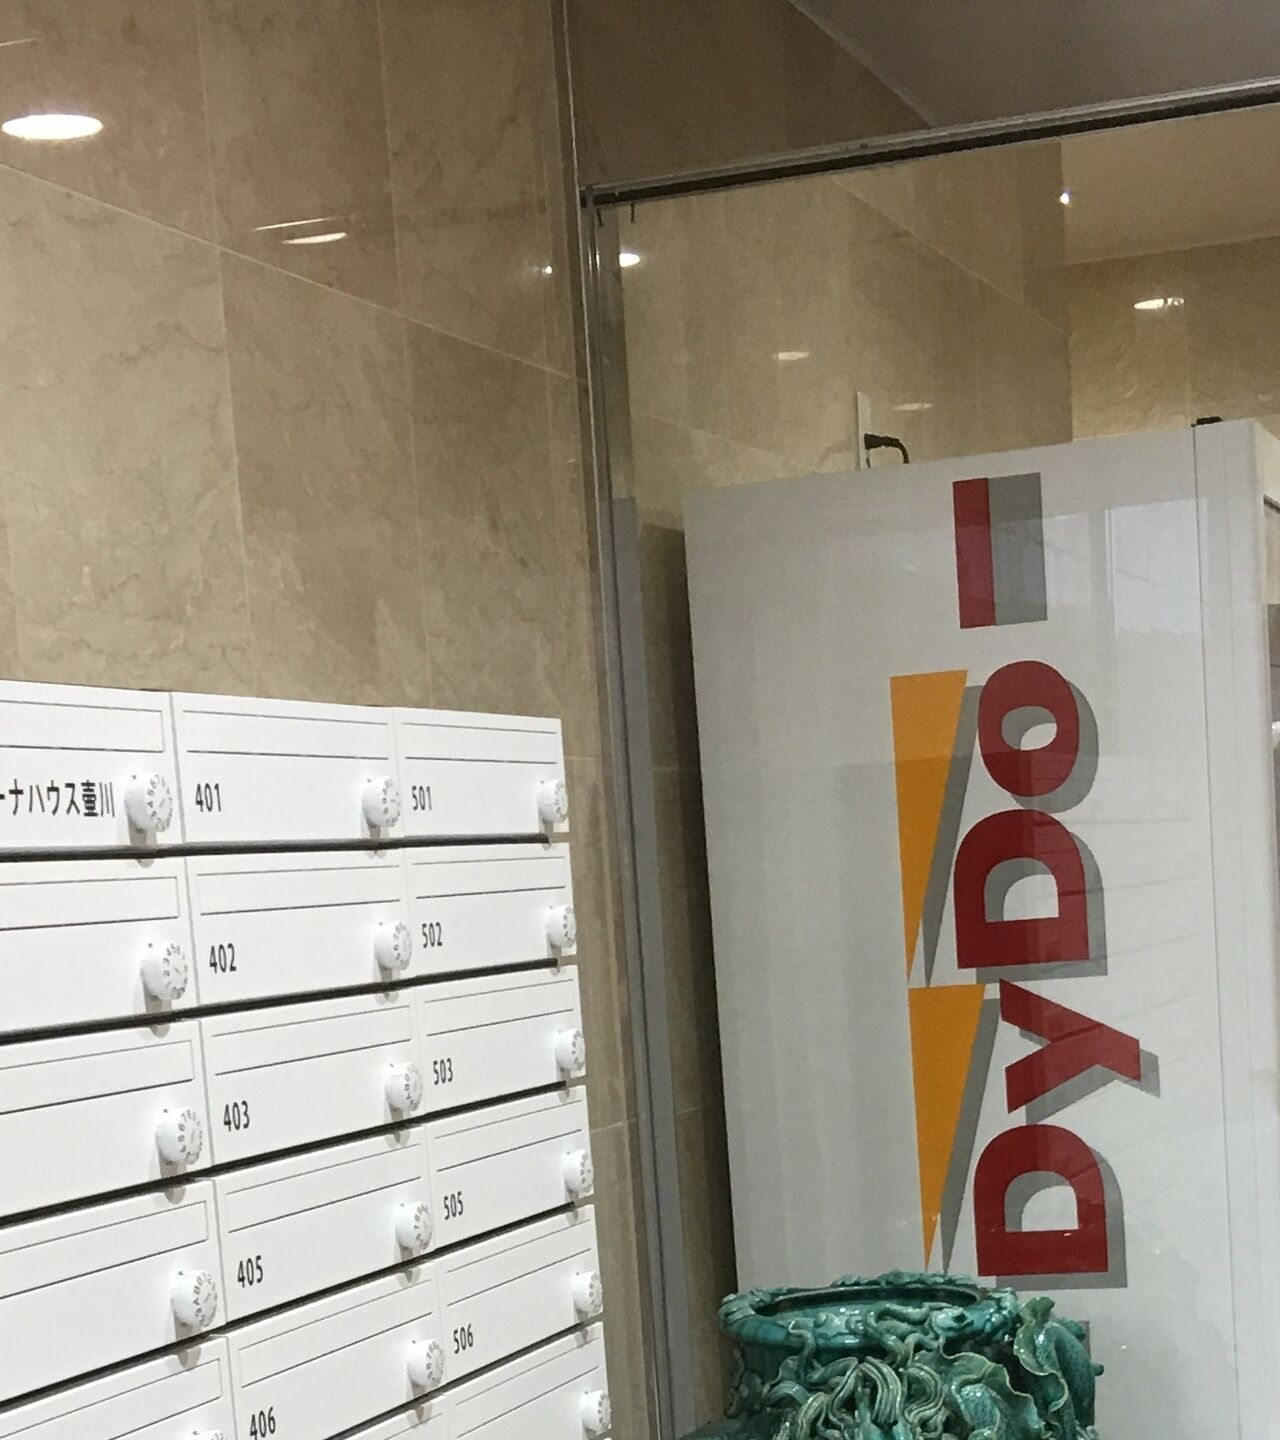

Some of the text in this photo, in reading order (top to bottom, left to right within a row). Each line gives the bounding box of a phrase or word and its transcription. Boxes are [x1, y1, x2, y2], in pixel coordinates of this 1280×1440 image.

[195, 782, 222, 812] 401
[411, 785, 432, 811] 501
[421, 921, 443, 949] 502
[209, 942, 237, 974] 402
[953, 660, 1141, 1276] DyDo
[432, 1057, 454, 1086] 503
[223, 1100, 250, 1132] 403
[443, 1191, 464, 1221] 505
[237, 1254, 264, 1288] 405
[453, 1323, 474, 1355] 506
[249, 1406, 276, 1440] 406
